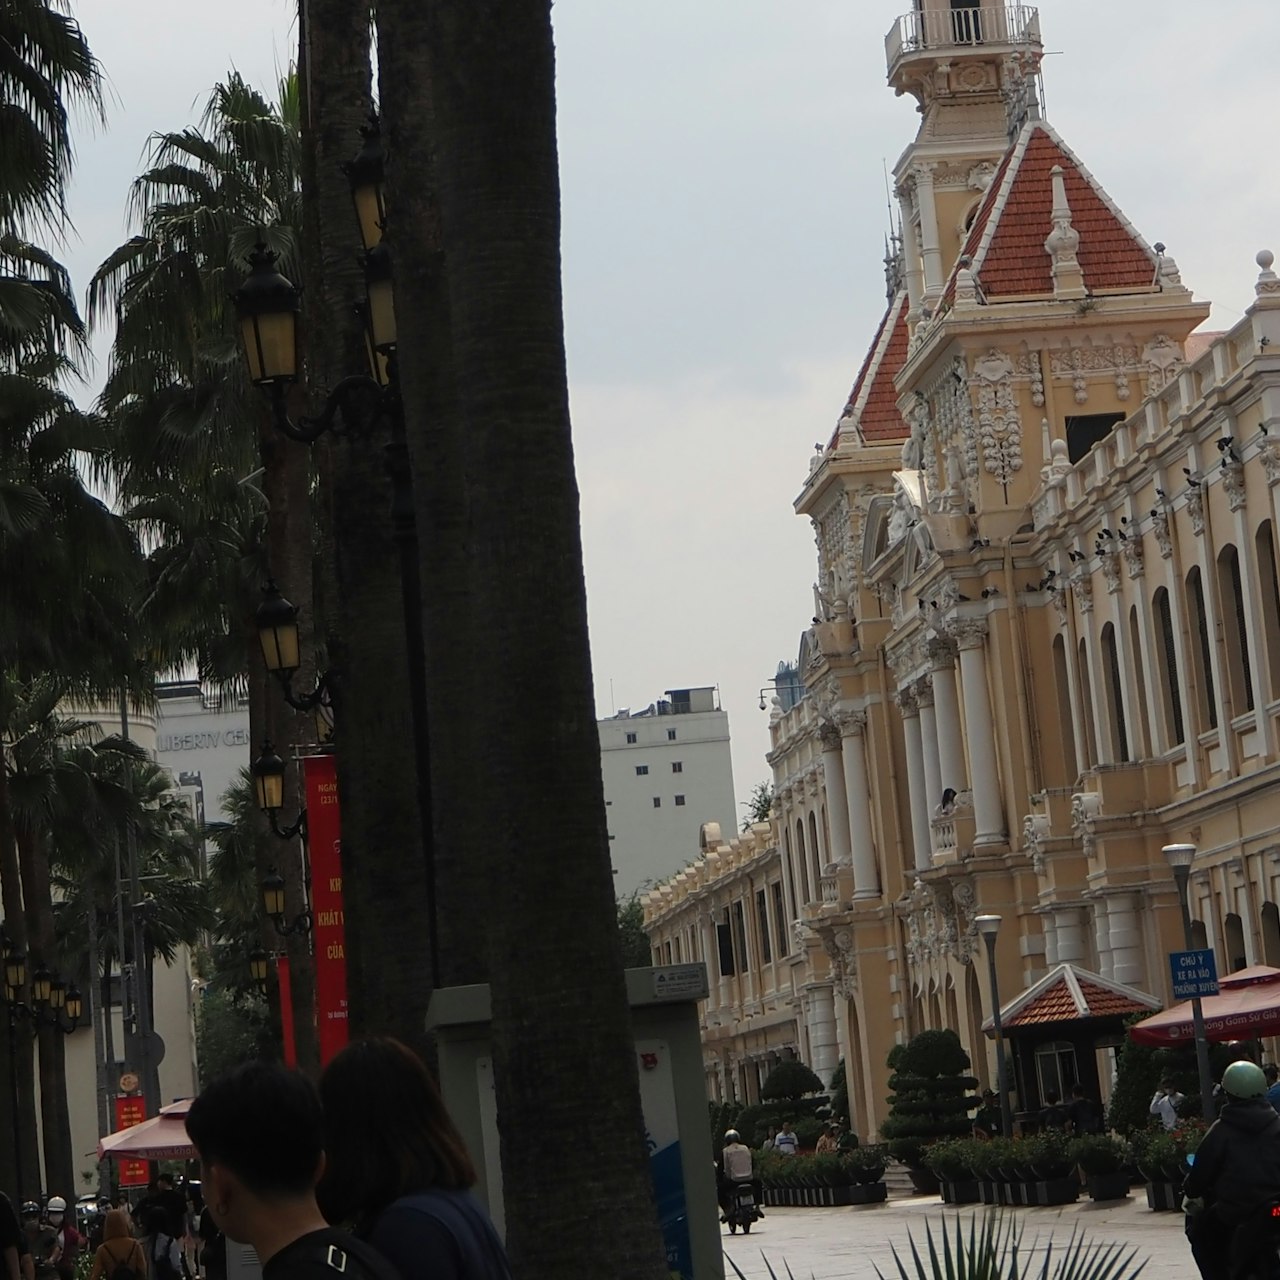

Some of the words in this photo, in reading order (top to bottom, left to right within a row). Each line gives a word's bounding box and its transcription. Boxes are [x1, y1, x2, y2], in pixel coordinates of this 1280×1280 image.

[157, 730, 220, 752] LIBERTY
[1180, 953, 1196, 967] CHÚ
[1197, 952, 1204, 965] Ý
[1177, 972, 1186, 981] XE
[1187, 970, 1197, 980] RA
